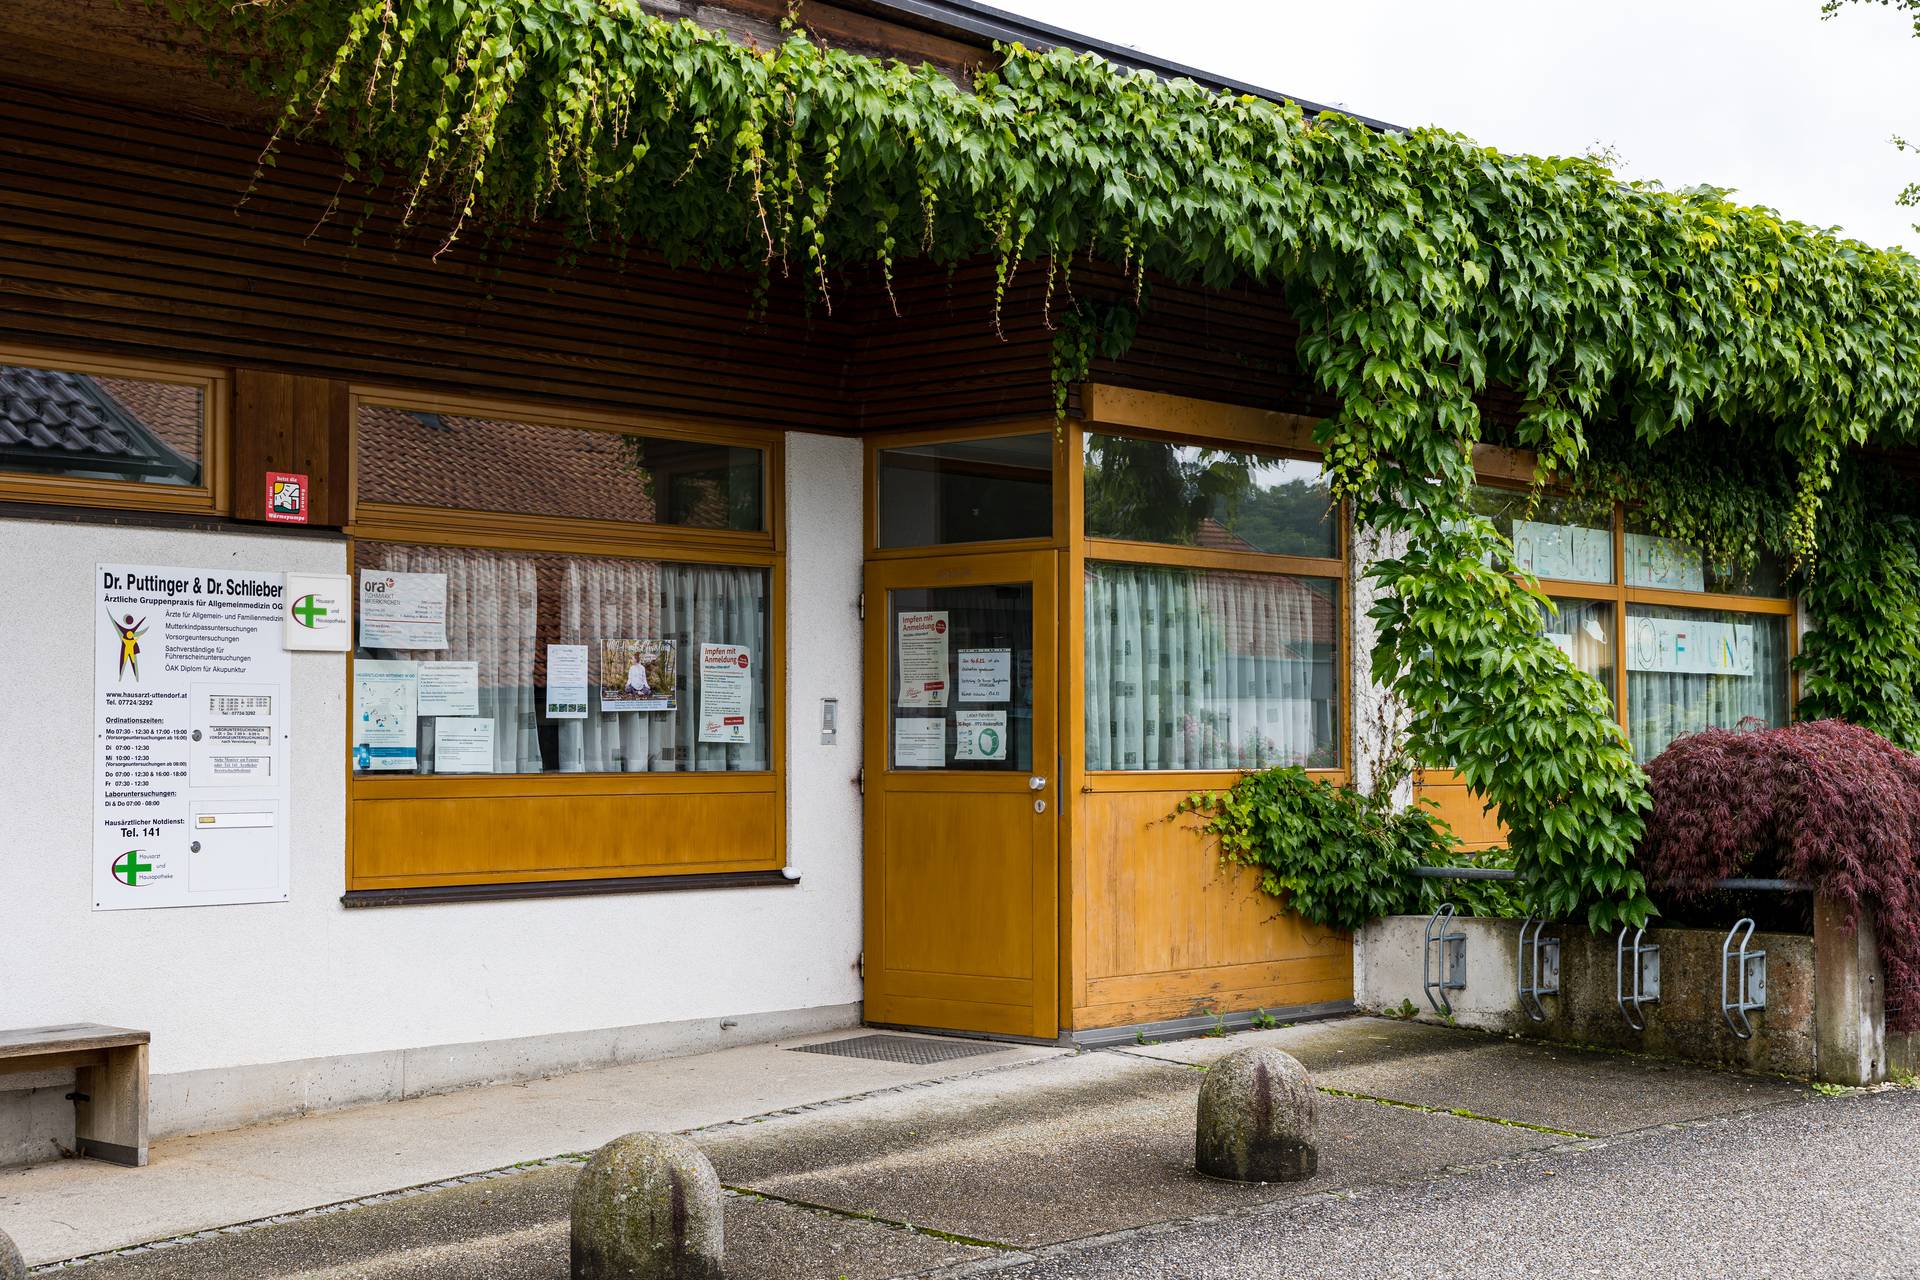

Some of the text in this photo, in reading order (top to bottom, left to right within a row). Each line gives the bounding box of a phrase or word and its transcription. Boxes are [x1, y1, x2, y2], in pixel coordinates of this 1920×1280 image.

[104, 572, 283, 597] Dr. Puttinger & Dr. Schlieber
[364, 580, 385, 593] ora
[104, 593, 138, 603] Ärztliche
[140, 596, 194, 606] Gruppenpraxis
[208, 600, 270, 610] Allgemeinmedizin
[166, 609, 180, 618] Ärzte
[192, 612, 223, 620] Allgemein-
[903, 615, 922, 624] Impfen
[165, 623, 257, 633] Mutterkindpassuntersuchungen
[903, 623, 936, 631] Anmeldung
[165, 633, 239, 643] Vorsorgeuntersuchungen
[165, 645, 215, 654] Sachverständige
[705, 648, 726, 656] Impfen
[165, 653, 251, 662] Führerscheinuntersuchungen
[705, 656, 737, 665] Anmeldung
[121, 828, 160, 837] Tel. 141
